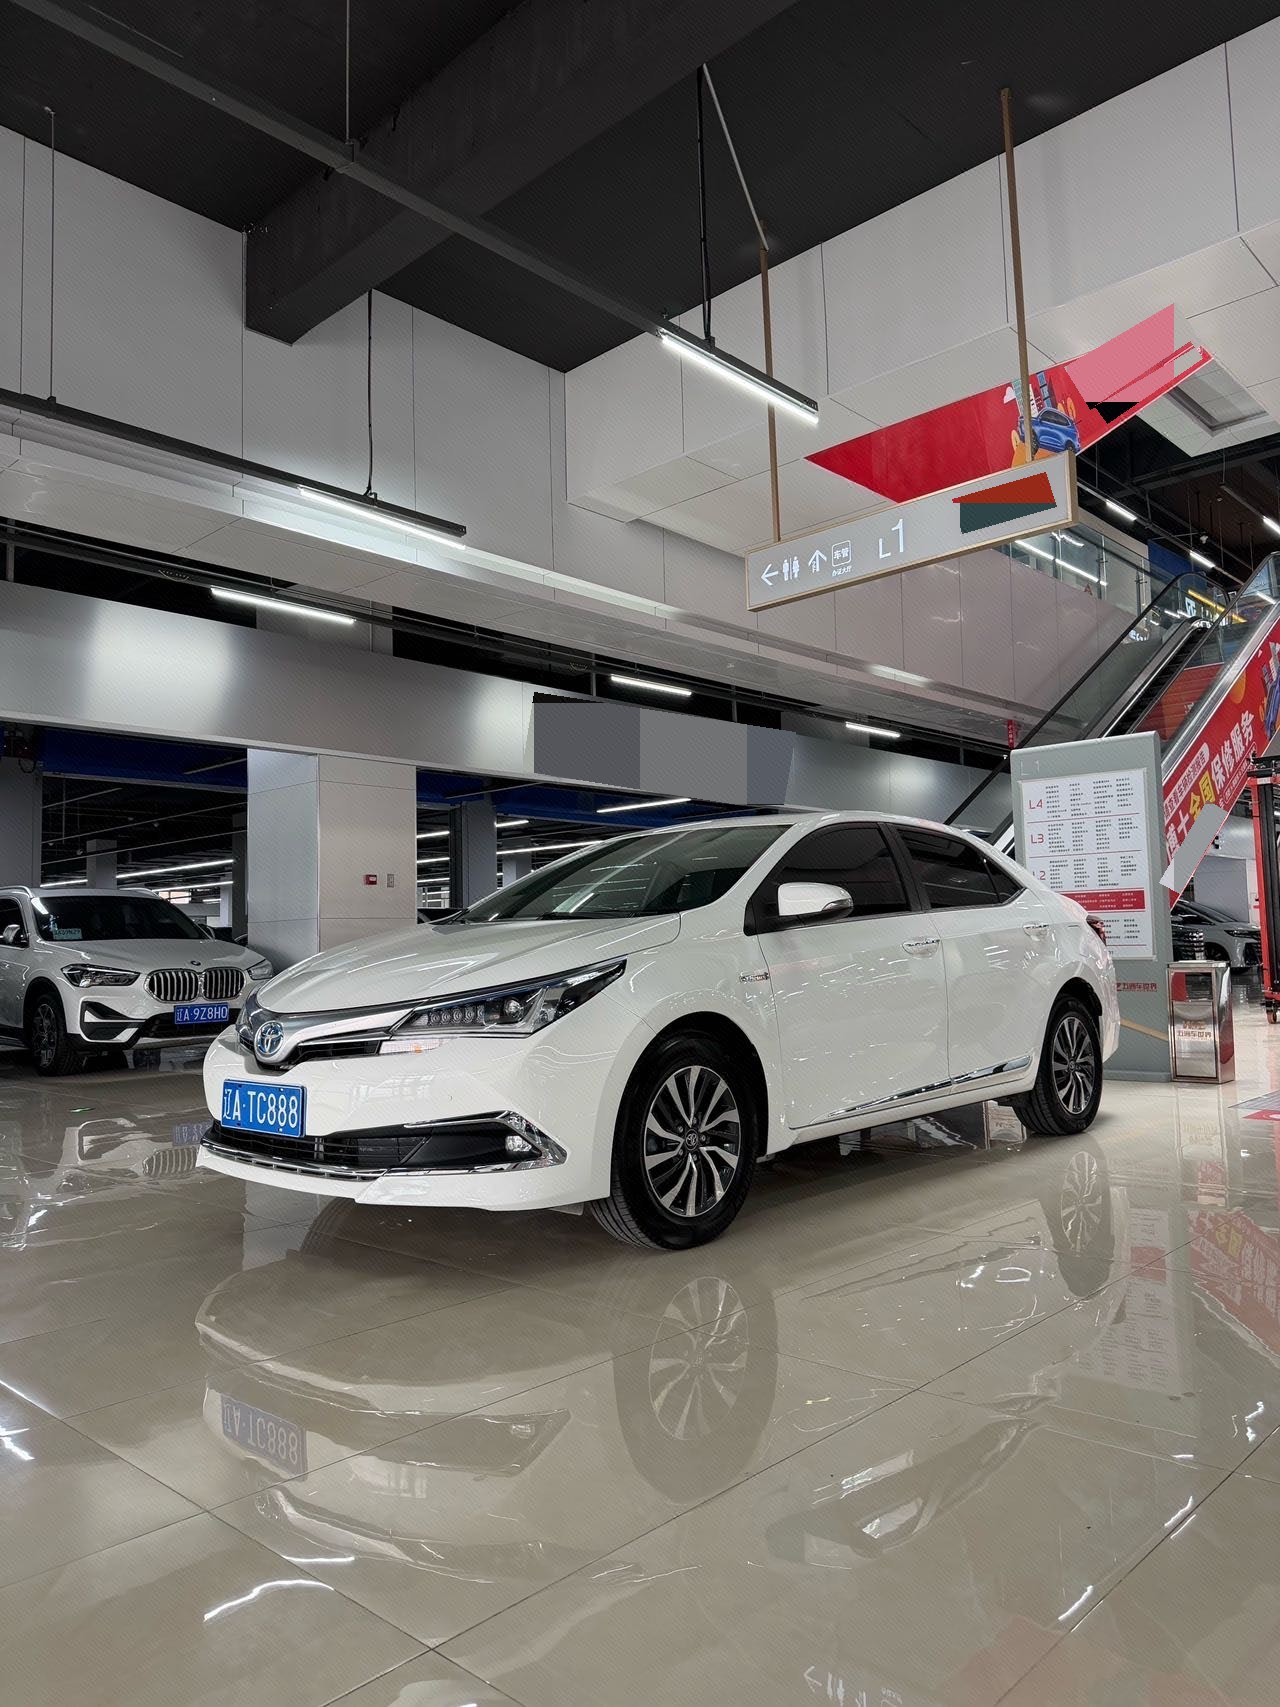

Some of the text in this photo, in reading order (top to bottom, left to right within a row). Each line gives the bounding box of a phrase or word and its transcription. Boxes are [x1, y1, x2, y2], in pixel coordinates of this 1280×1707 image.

[879, 518, 904, 559] L1
[833, 547, 849, 560] 车管
[1028, 799, 1044, 810] L4
[1030, 833, 1045, 844] L3
